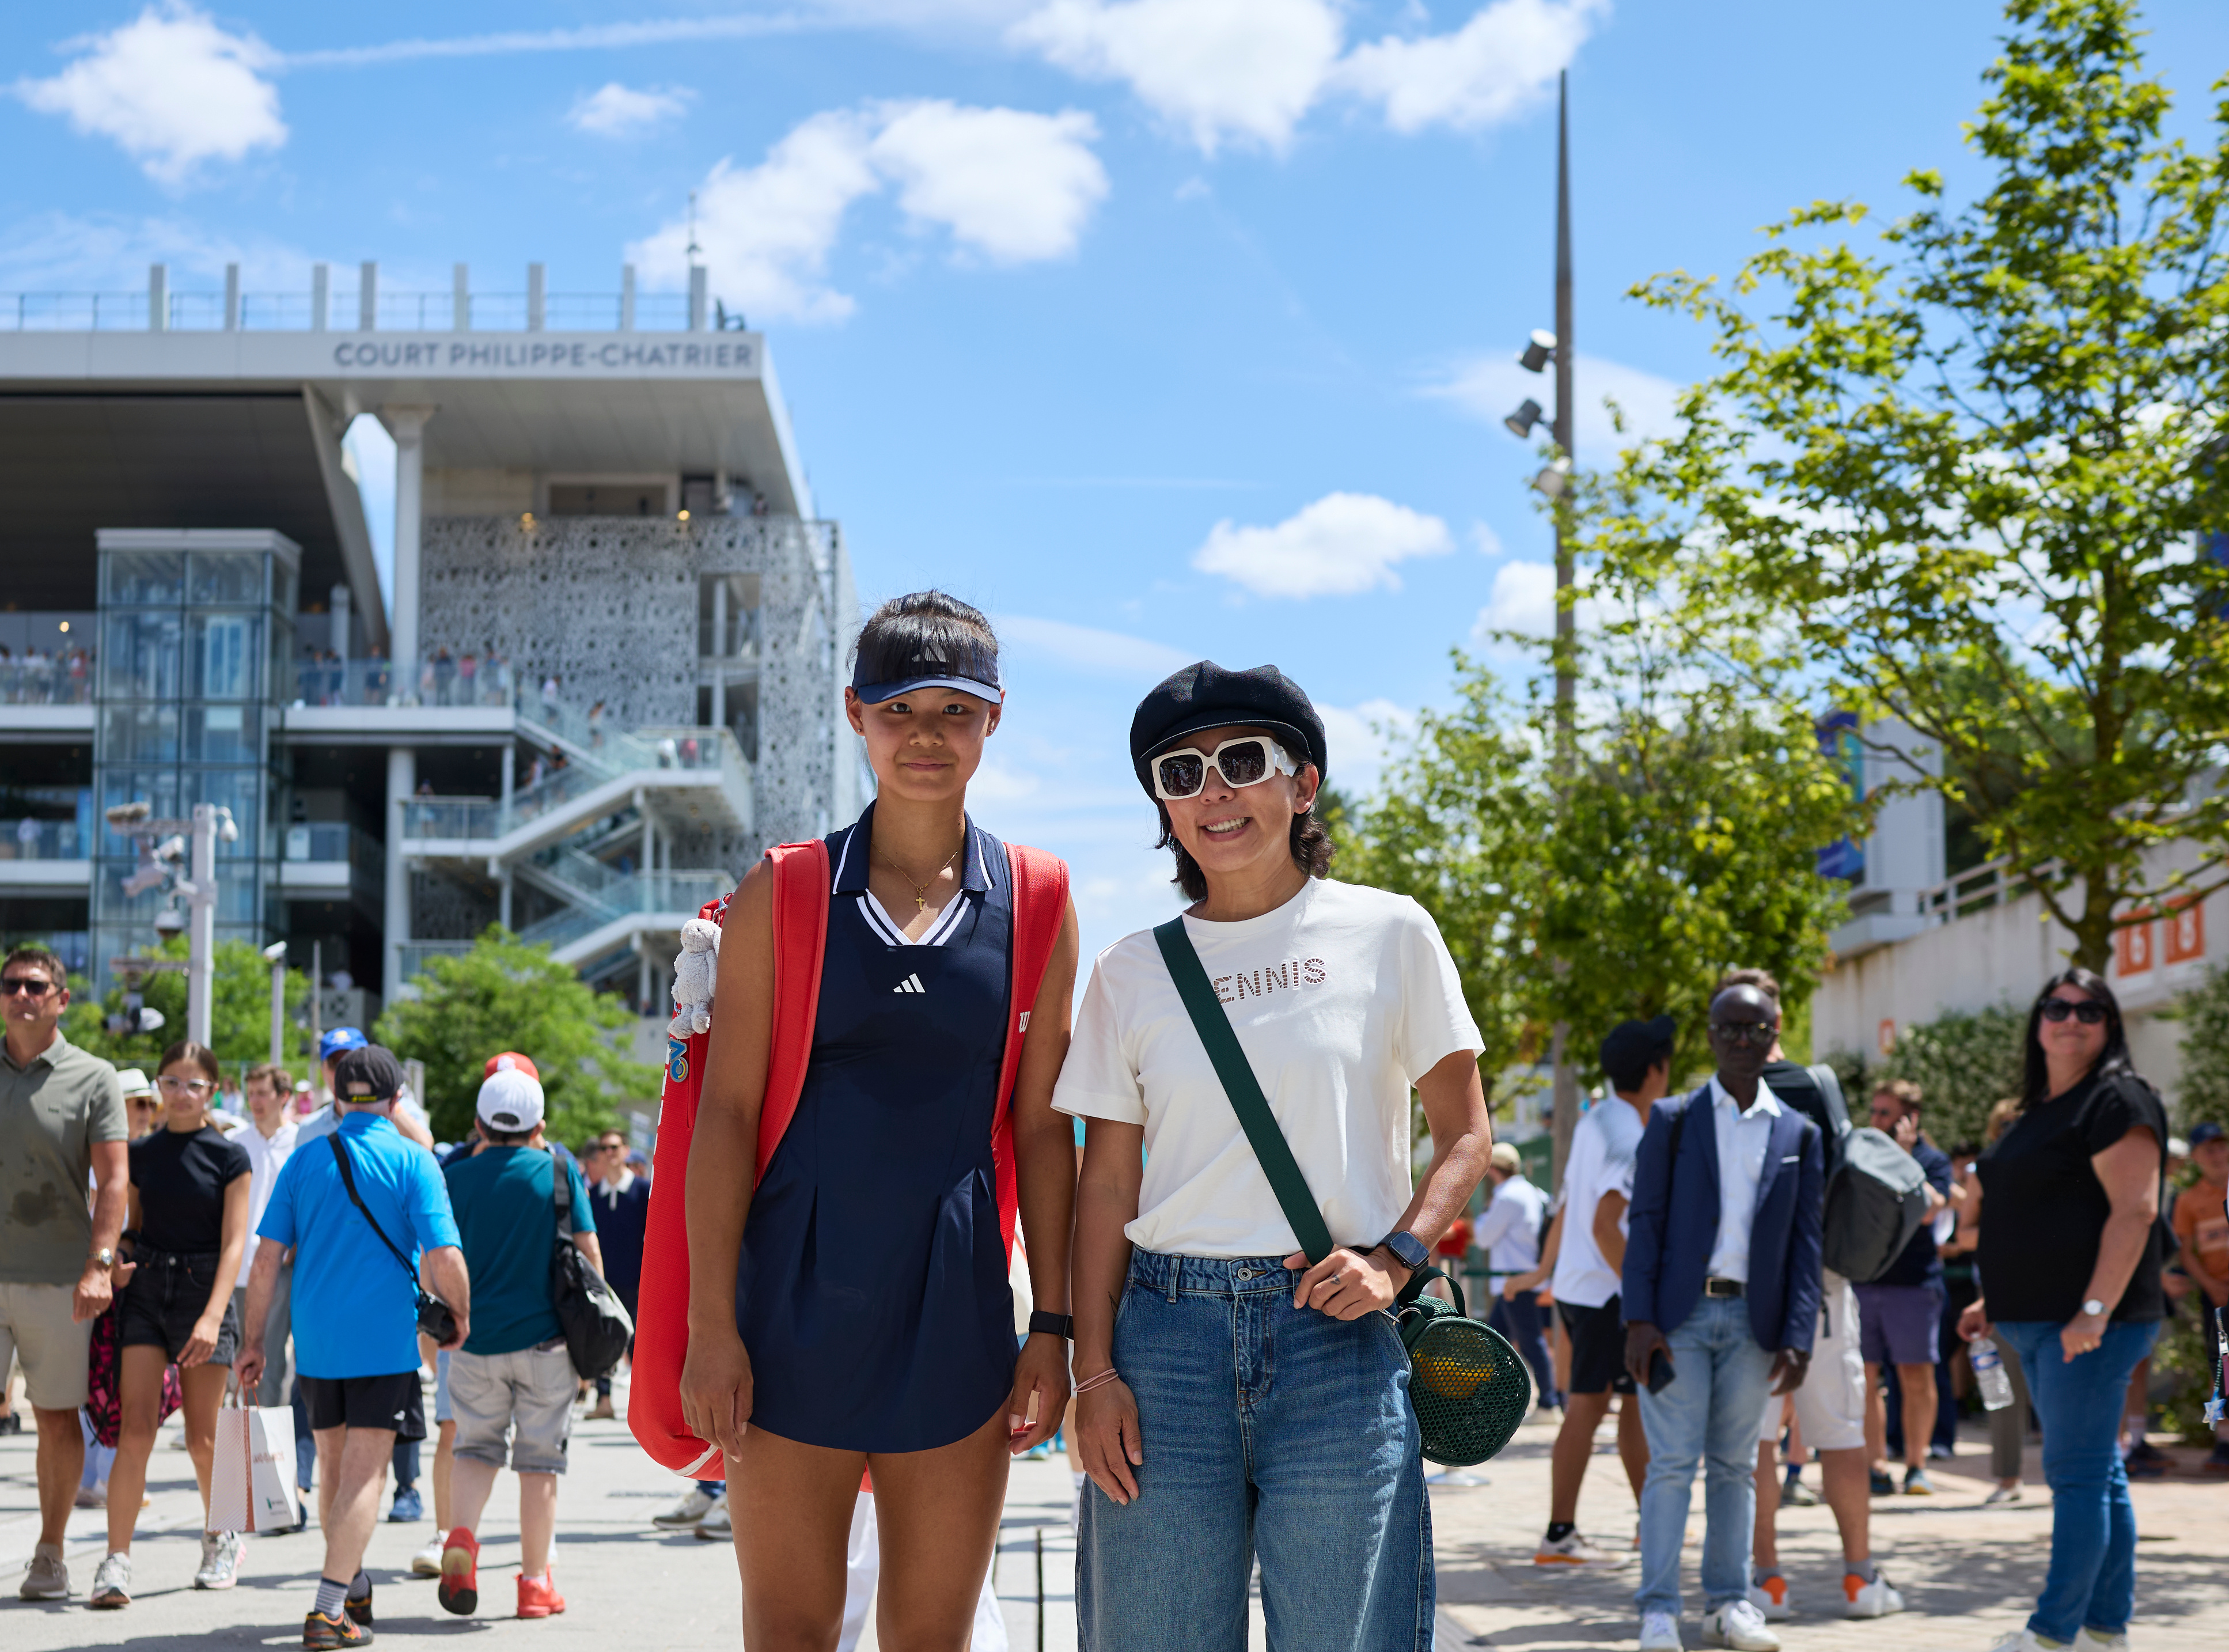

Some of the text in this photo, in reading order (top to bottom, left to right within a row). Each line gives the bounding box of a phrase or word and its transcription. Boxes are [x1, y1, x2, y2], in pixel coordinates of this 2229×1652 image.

[333, 343, 753, 368] COURT PHILIPPE-CHATRIER
[1212, 957, 1327, 1005] ENNIS
